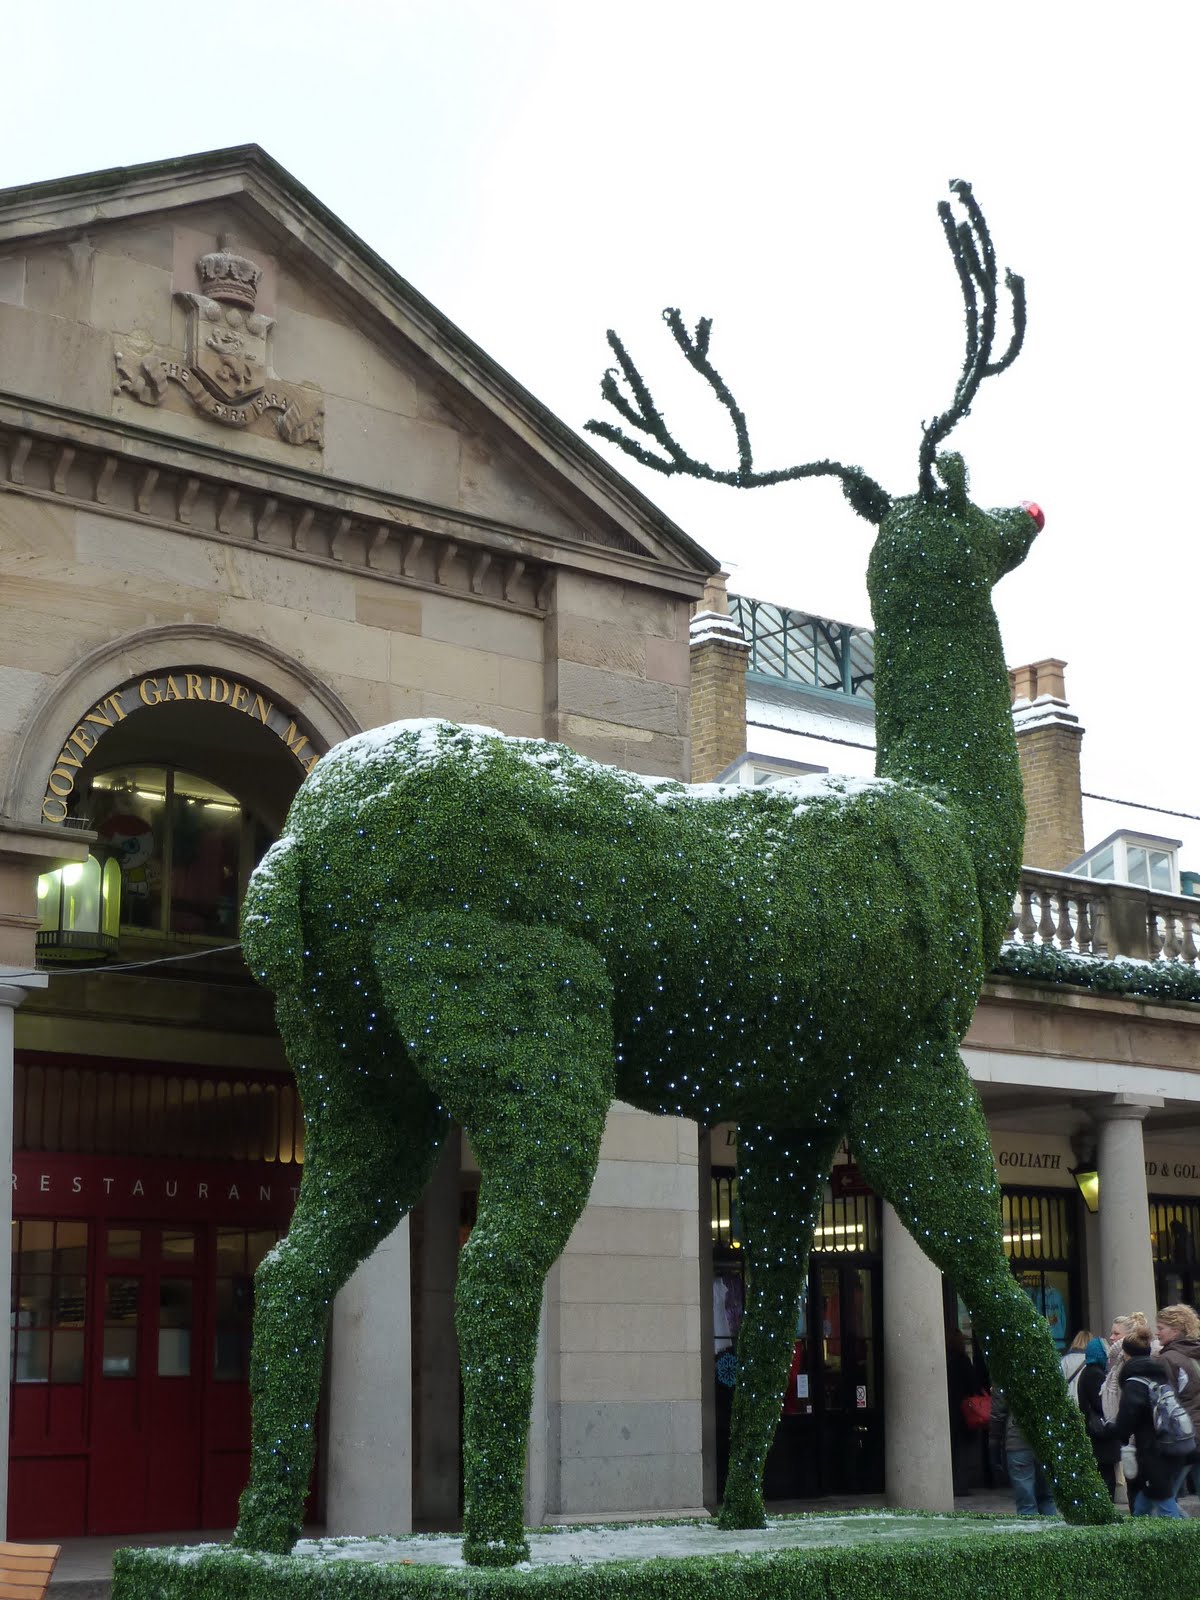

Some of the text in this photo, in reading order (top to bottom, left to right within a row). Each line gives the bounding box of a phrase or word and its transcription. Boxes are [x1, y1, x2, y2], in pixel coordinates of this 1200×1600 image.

[212, 403, 249, 421] SARA
[257, 393, 288, 410] SARA
[42, 691, 128, 823] COVENT
[139, 673, 273, 725] GARDEN
[1000, 1151, 1061, 1169] GOLIATH
[1161, 1162, 1169, 1177] &
[11, 1173, 301, 1201] RESTAURANT
